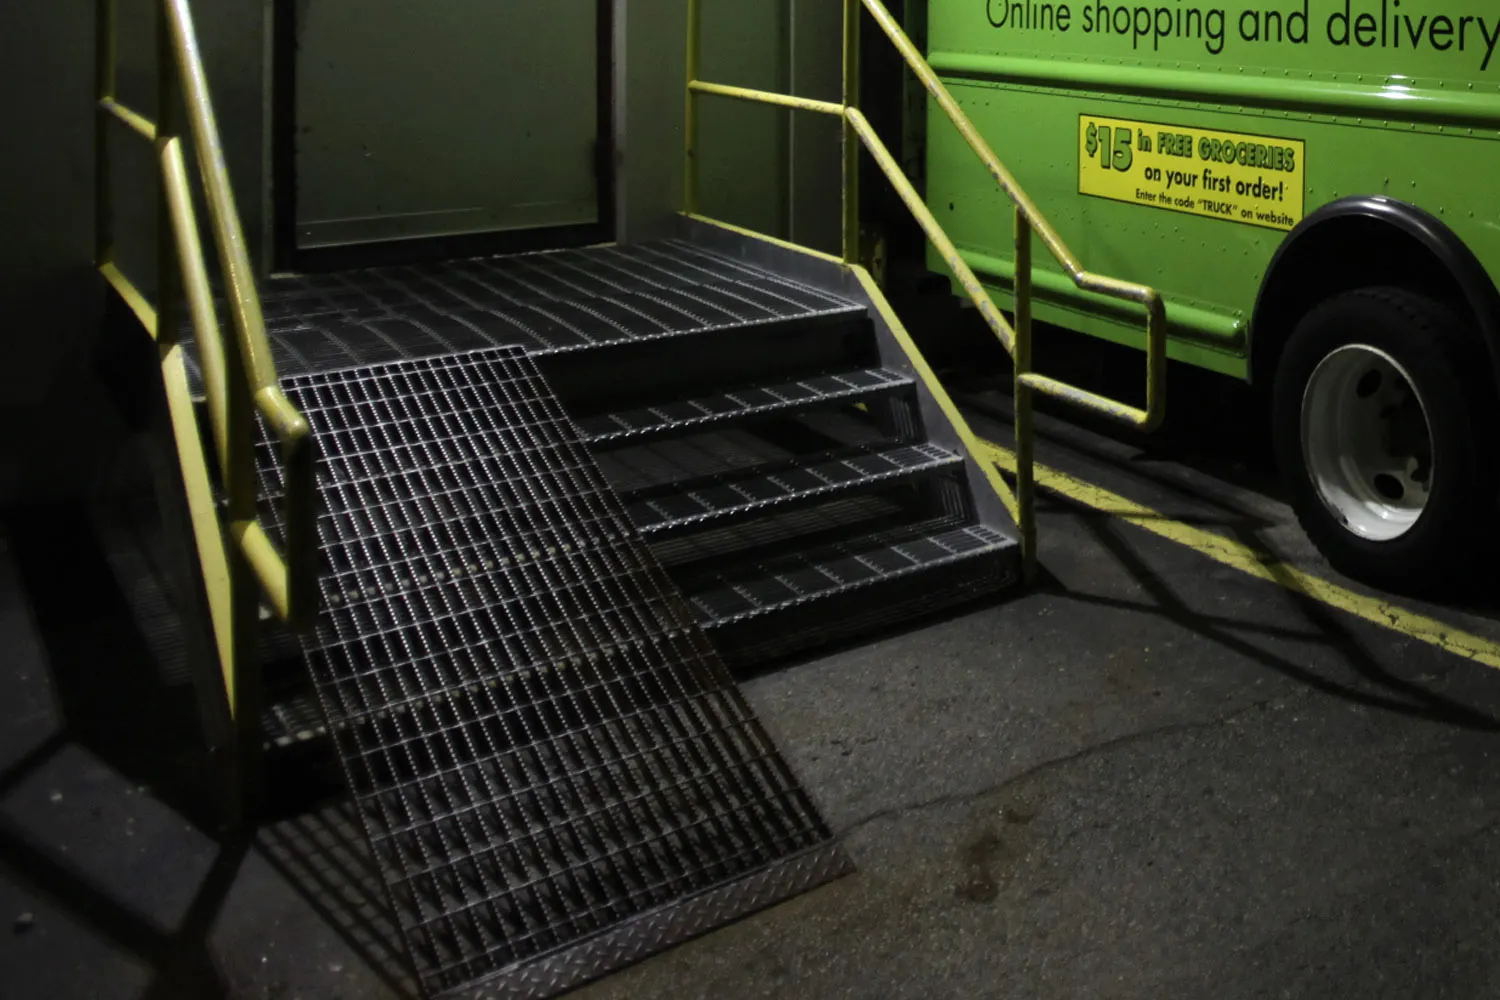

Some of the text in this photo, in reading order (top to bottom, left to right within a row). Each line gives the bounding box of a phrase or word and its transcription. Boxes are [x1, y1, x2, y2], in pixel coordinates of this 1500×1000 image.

[1086, 122, 1295, 173] $15 in FREE GROCERIES
[1144, 166, 1284, 201] on your first order!
[1135, 188, 1156, 201] Enter
[1158, 191, 1173, 204] the
[1174, 195, 1195, 209] code
[1240, 208, 1253, 219] on
[1256, 210, 1294, 227] website
